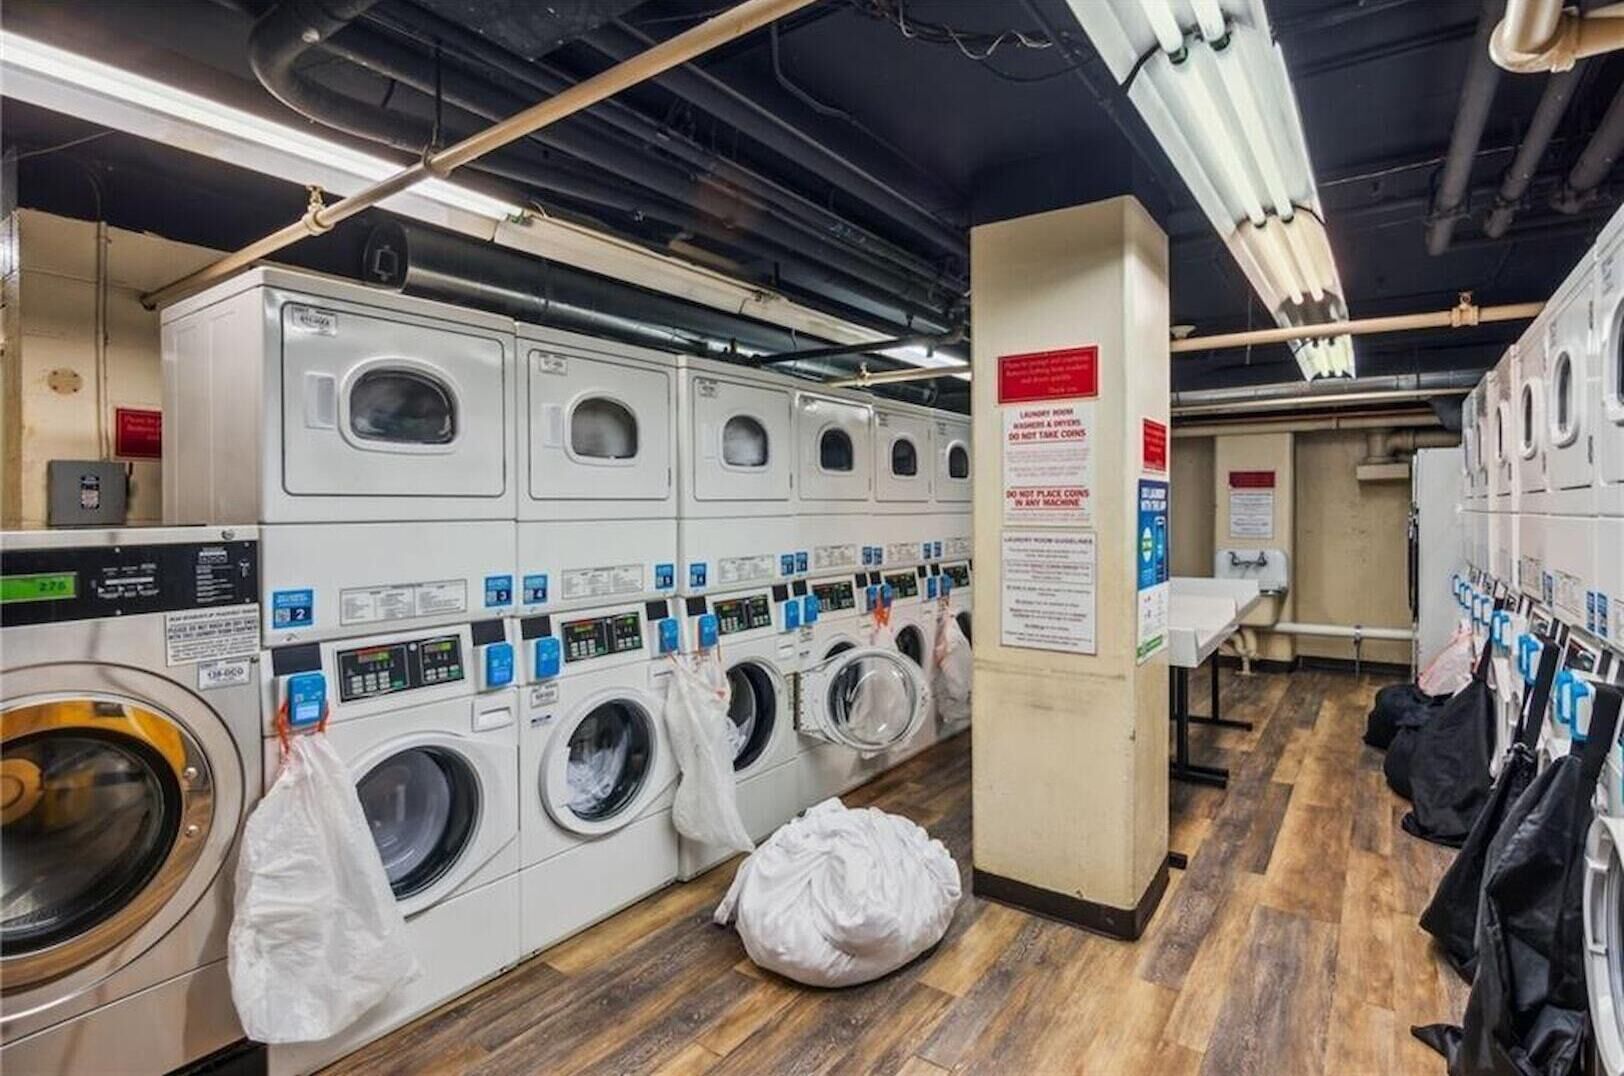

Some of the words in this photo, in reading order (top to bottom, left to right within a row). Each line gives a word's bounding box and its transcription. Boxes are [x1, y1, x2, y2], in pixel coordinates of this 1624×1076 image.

[1019, 409, 1050, 419] LAUNDRY
[1053, 408, 1074, 416] ROOM
[1013, 421, 1045, 429] WASHERS
[1054, 419, 1081, 428] DRYERS
[1008, 432, 1019, 441] DO
[1021, 432, 1037, 440] NOT
[1039, 430, 1058, 439] TAKE
[1060, 429, 1087, 439] COINS
[1006, 490, 1017, 498] DO
[1019, 490, 1034, 498] NOT
[1036, 490, 1062, 498] PLACE
[1064, 489, 1090, 498] COINS
[1014, 499, 1024, 507] IN
[1025, 499, 1040, 507] ANY
[1043, 499, 1080, 507] MACHINE
[296, 608, 305, 620] 2
